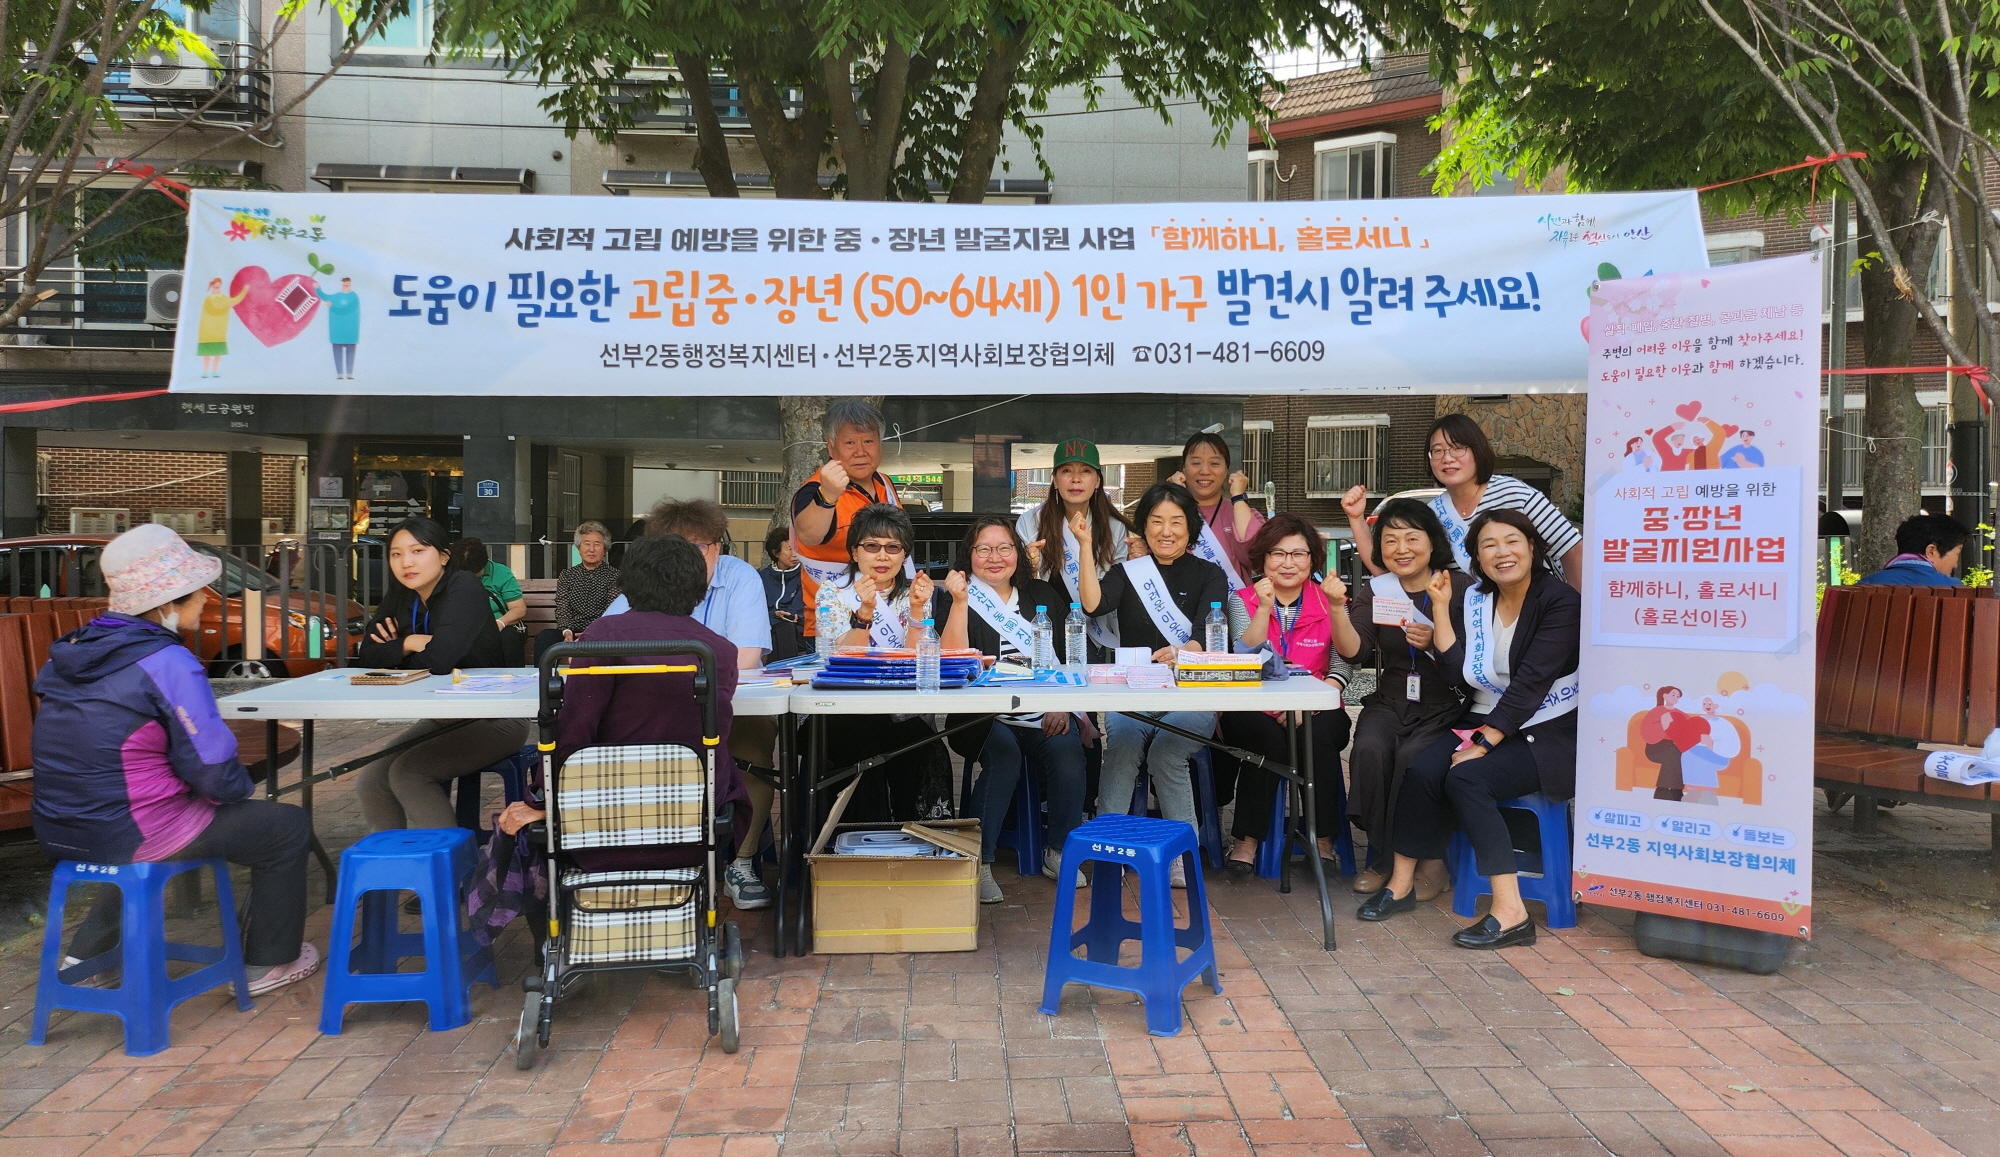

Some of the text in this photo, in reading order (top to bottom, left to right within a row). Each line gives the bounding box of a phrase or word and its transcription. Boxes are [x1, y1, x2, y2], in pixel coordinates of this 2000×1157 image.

[504, 227, 595, 252] 사회적
[602, 228, 663, 252] 고립
[671, 227, 759, 252] 예방을
[767, 227, 827, 252] 위한
[954, 227, 1070, 252] 발굴지원
[1078, 226, 1135, 251] 사업
[1623, 226, 1654, 241] 안산
[388, 274, 497, 326] 도움이
[507, 269, 620, 329] 필요한
[853, 270, 1061, 324] (50~64세)
[1072, 272, 1126, 321] 1인
[1136, 275, 1208, 323] 가구
[1217, 268, 1330, 327] 발견시
[1339, 266, 1414, 326] 알려
[1424, 271, 1541, 319] 주세요!
[1687, 313, 1715, 327] 질병,
[1720, 309, 1757, 324] 공과금
[1761, 305, 1787, 319] 체납
[1790, 303, 1804, 316] 등
[1154, 340, 1325, 365] 031-481-6609
[1602, 329, 1804, 359] 주변의 어려운 이웃을 함께 찾아주세요!
[1601, 354, 1804, 382] 도움이 필요한 이웃과 함께 하겠습니다.
[1064, 440, 1088, 458] NY
[483, 488, 494, 496] 30
[1613, 482, 1777, 500] 사회적 고립 예방을 위한
[1603, 536, 1786, 563] 발굴지원사업
[968, 584, 996, 612] 안산시
[1143, 578, 1166, 613] 어려운
[1608, 580, 1778, 601] 함께하니, 홀로서니
[1634, 608, 1748, 628] (홀로선이동)
[1604, 812, 1785, 846] 살피고 알리고 돌보는
[1585, 832, 1796, 875] 선부2동 지역사회보장협의체
[1609, 887, 1642, 901] 선부2동
[1645, 892, 1703, 911] 행정복지센터
[1706, 901, 1785, 922] 031-481-6609
